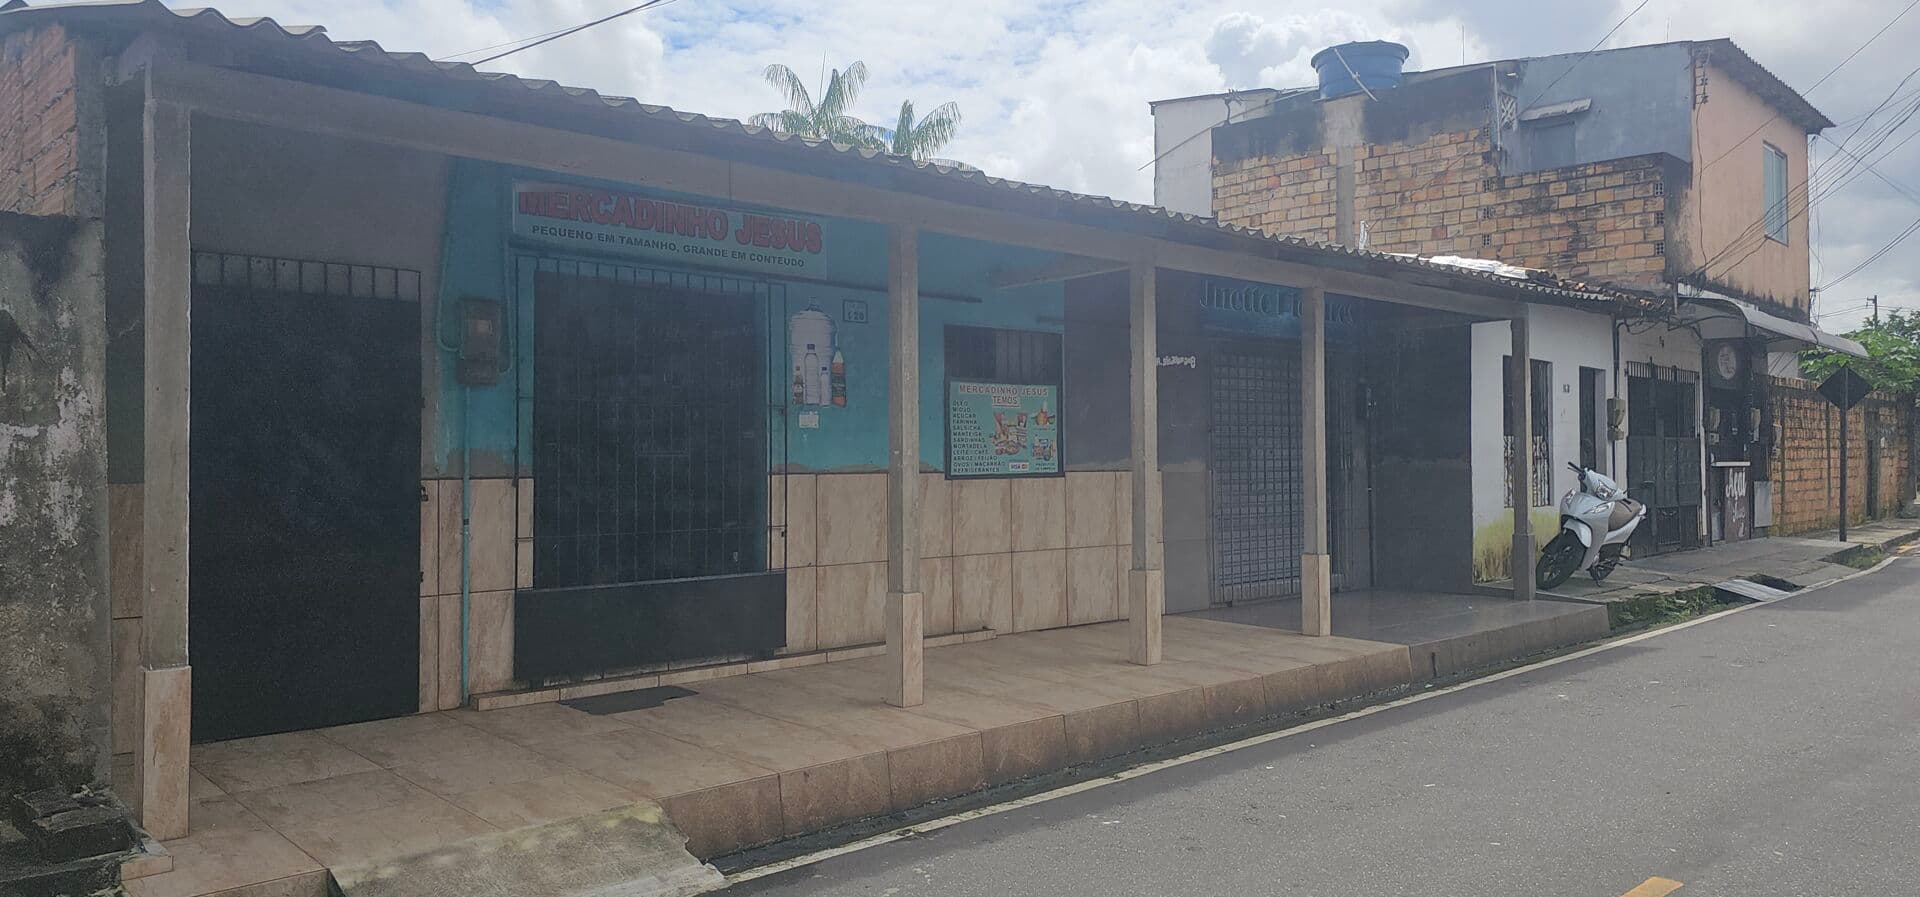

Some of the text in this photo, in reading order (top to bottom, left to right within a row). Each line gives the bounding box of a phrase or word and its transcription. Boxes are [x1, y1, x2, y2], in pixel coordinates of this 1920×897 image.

[518, 191, 823, 254] MERCADINHO JESUS
[531, 224, 593, 242] PEQUENO
[597, 231, 615, 244] EM
[619, 235, 679, 253] TAMANHO,
[683, 244, 728, 258] GRANDE
[731, 250, 747, 261] EM
[960, 385, 1048, 397] MERCADINHO JESUS
[992, 395, 1018, 405] TEMOS
